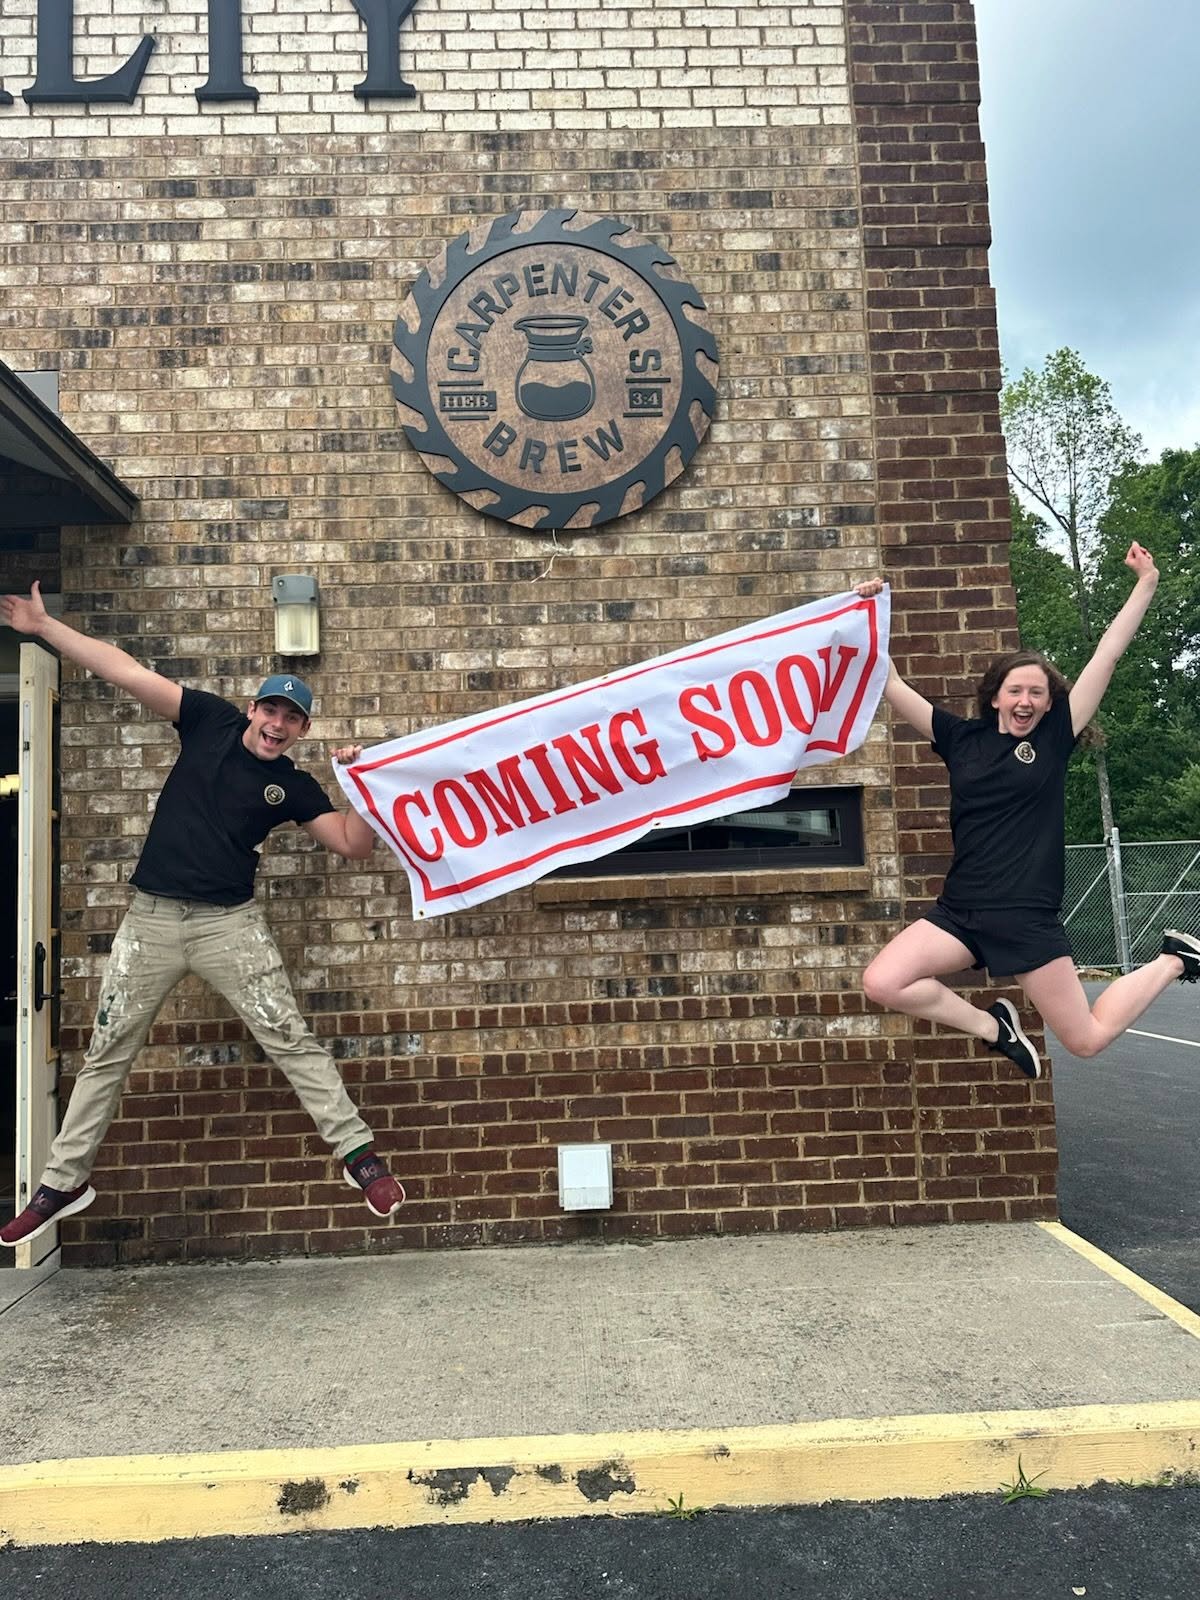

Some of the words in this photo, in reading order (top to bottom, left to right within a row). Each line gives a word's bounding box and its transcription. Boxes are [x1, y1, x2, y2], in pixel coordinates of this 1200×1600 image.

[444, 394, 493, 409] HEB.
[632, 392, 659, 406] 3:4
[482, 419, 624, 474] BREW
[392, 707, 668, 864] COMING
